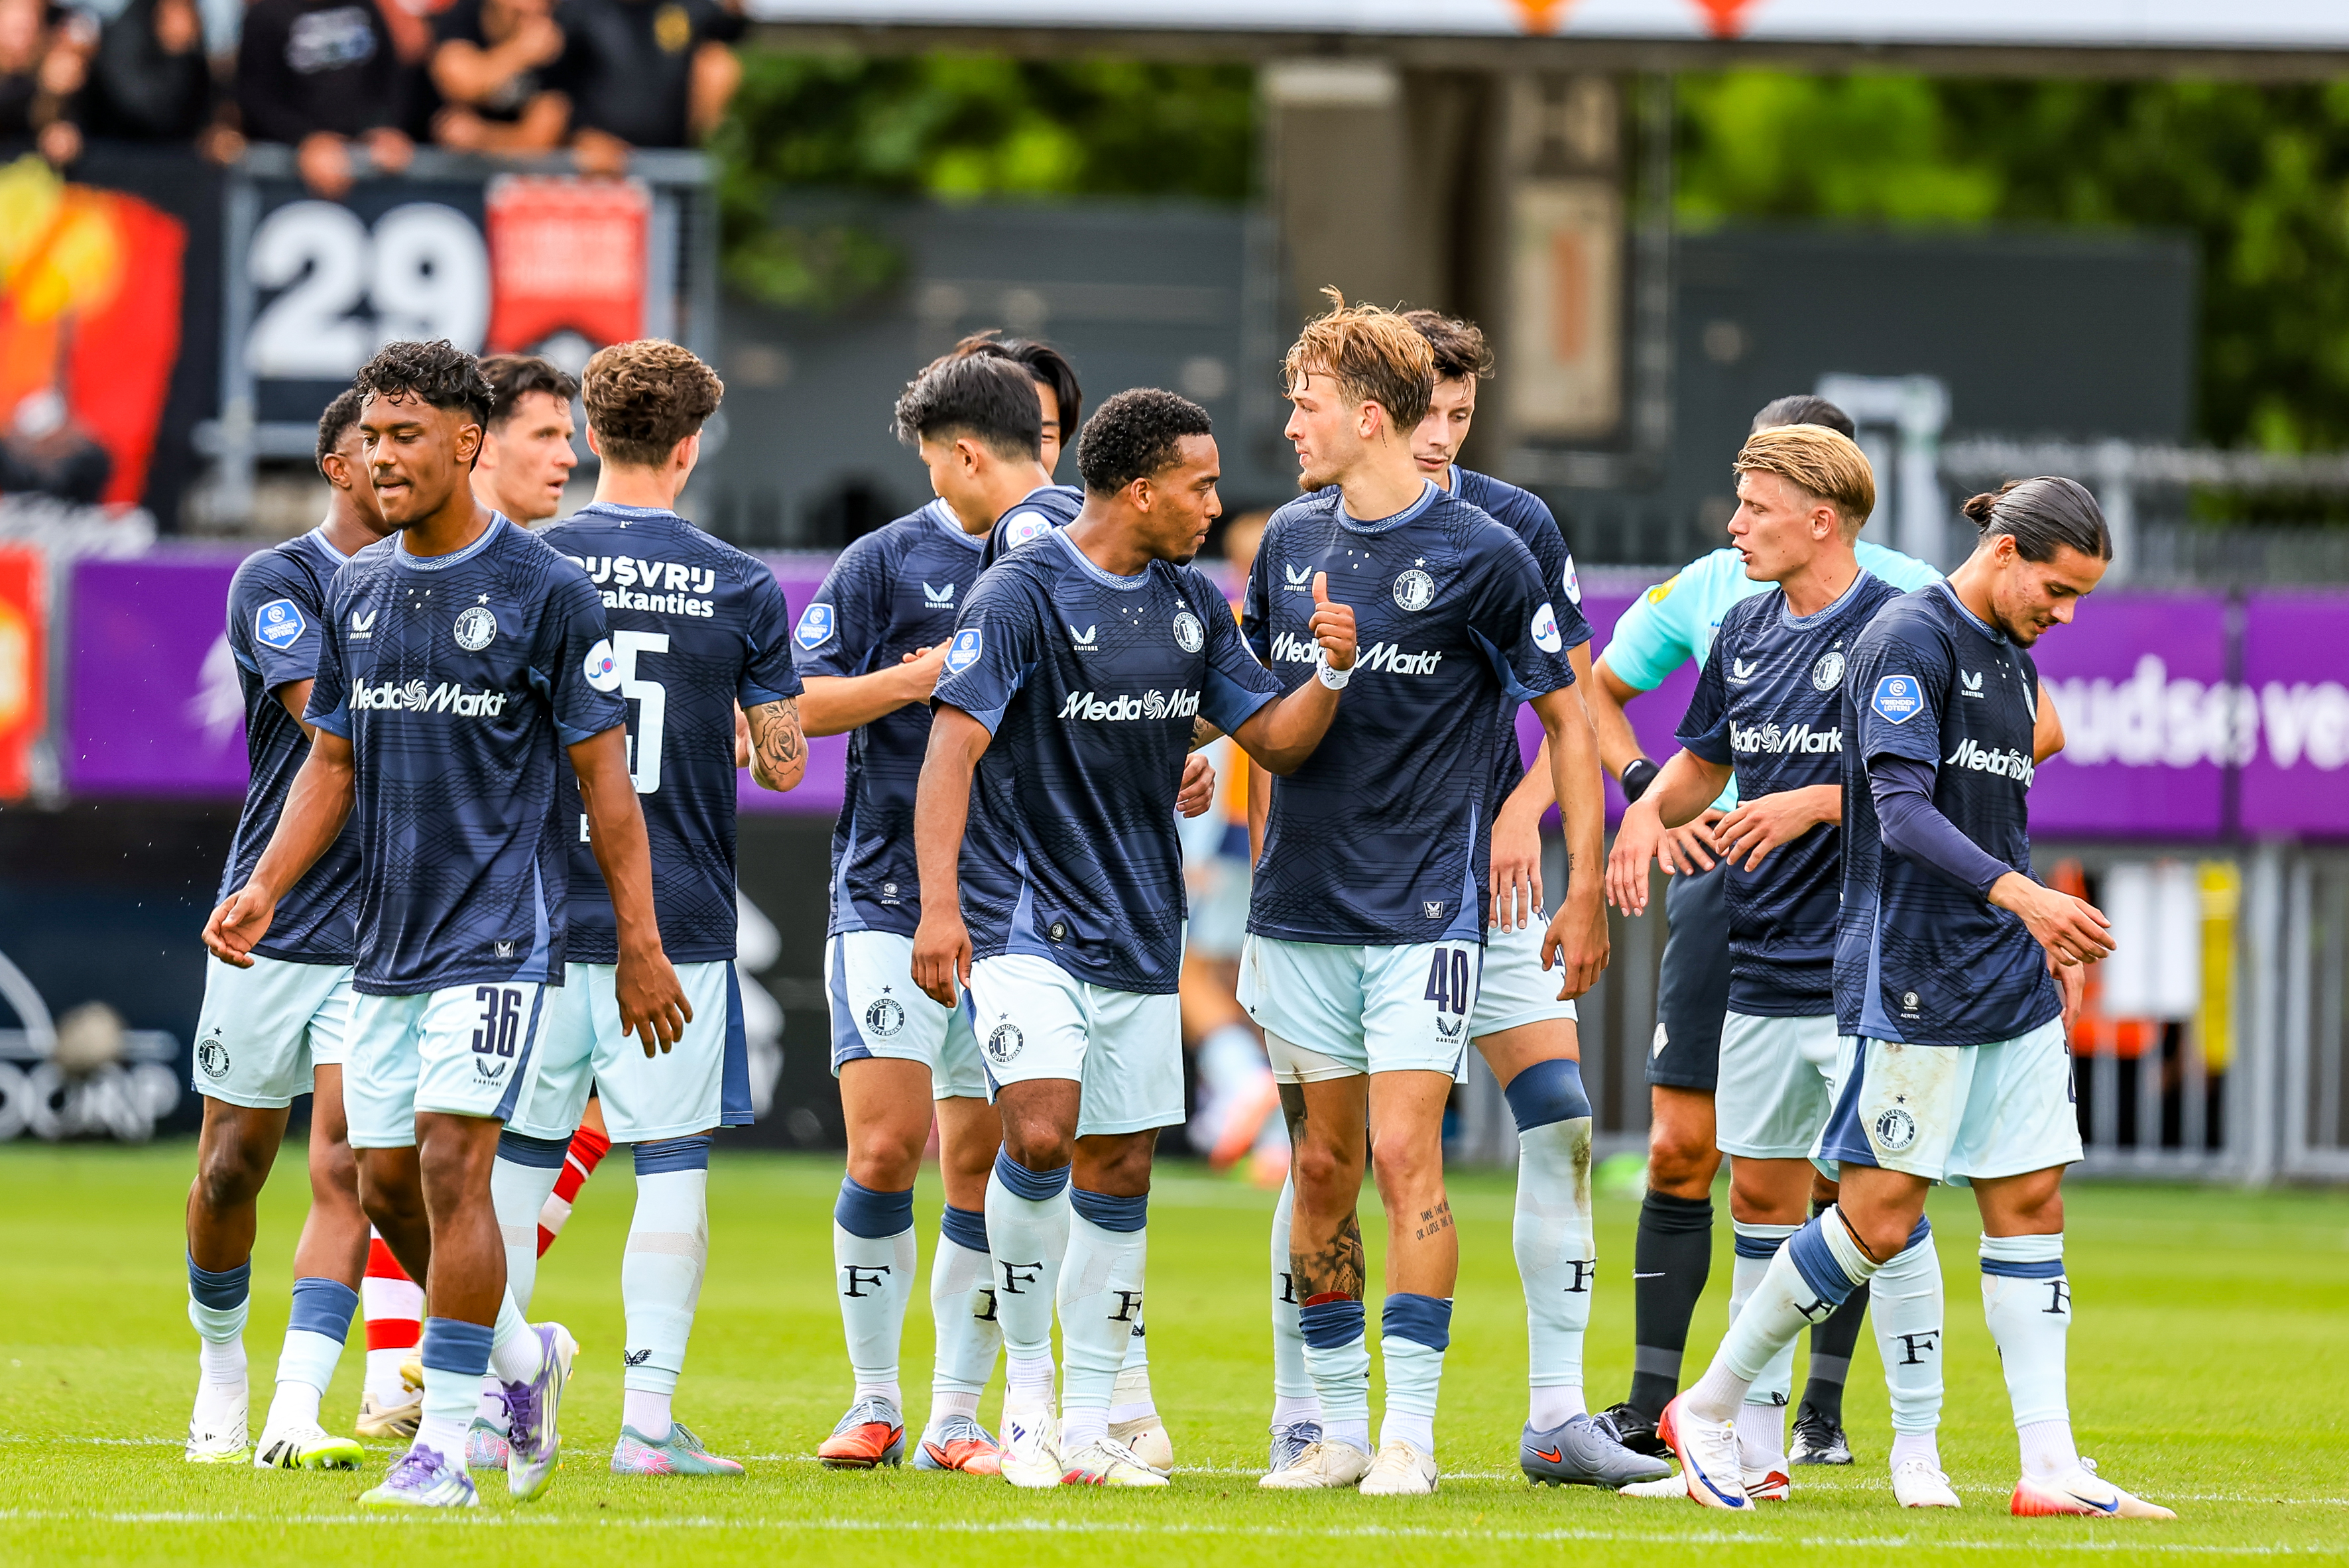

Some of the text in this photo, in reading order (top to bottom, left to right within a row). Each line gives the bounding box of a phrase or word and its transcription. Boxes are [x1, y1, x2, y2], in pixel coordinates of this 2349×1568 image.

[245, 199, 492, 379] 29
[1398, 571, 1432, 588] FEYENOORD
[598, 585, 715, 618] akanties
[1396, 593, 1429, 609] ROTTERDAM
[460, 609, 495, 627] FEYENOORD
[456, 631, 491, 649] ROTTERDAM
[423, 682, 508, 717] Markt
[1057, 688, 1201, 721] Media Mark
[1776, 723, 1843, 754] Mark
[1424, 947, 1469, 1016] 40
[471, 985, 522, 1058] 36
[990, 1024, 1021, 1042] FEYENOORD
[991, 1045, 1022, 1062] ROTTERDAM
[843, 1264, 891, 1297] F
[998, 1259, 1043, 1294] F
[1897, 1329, 1940, 1365] F
